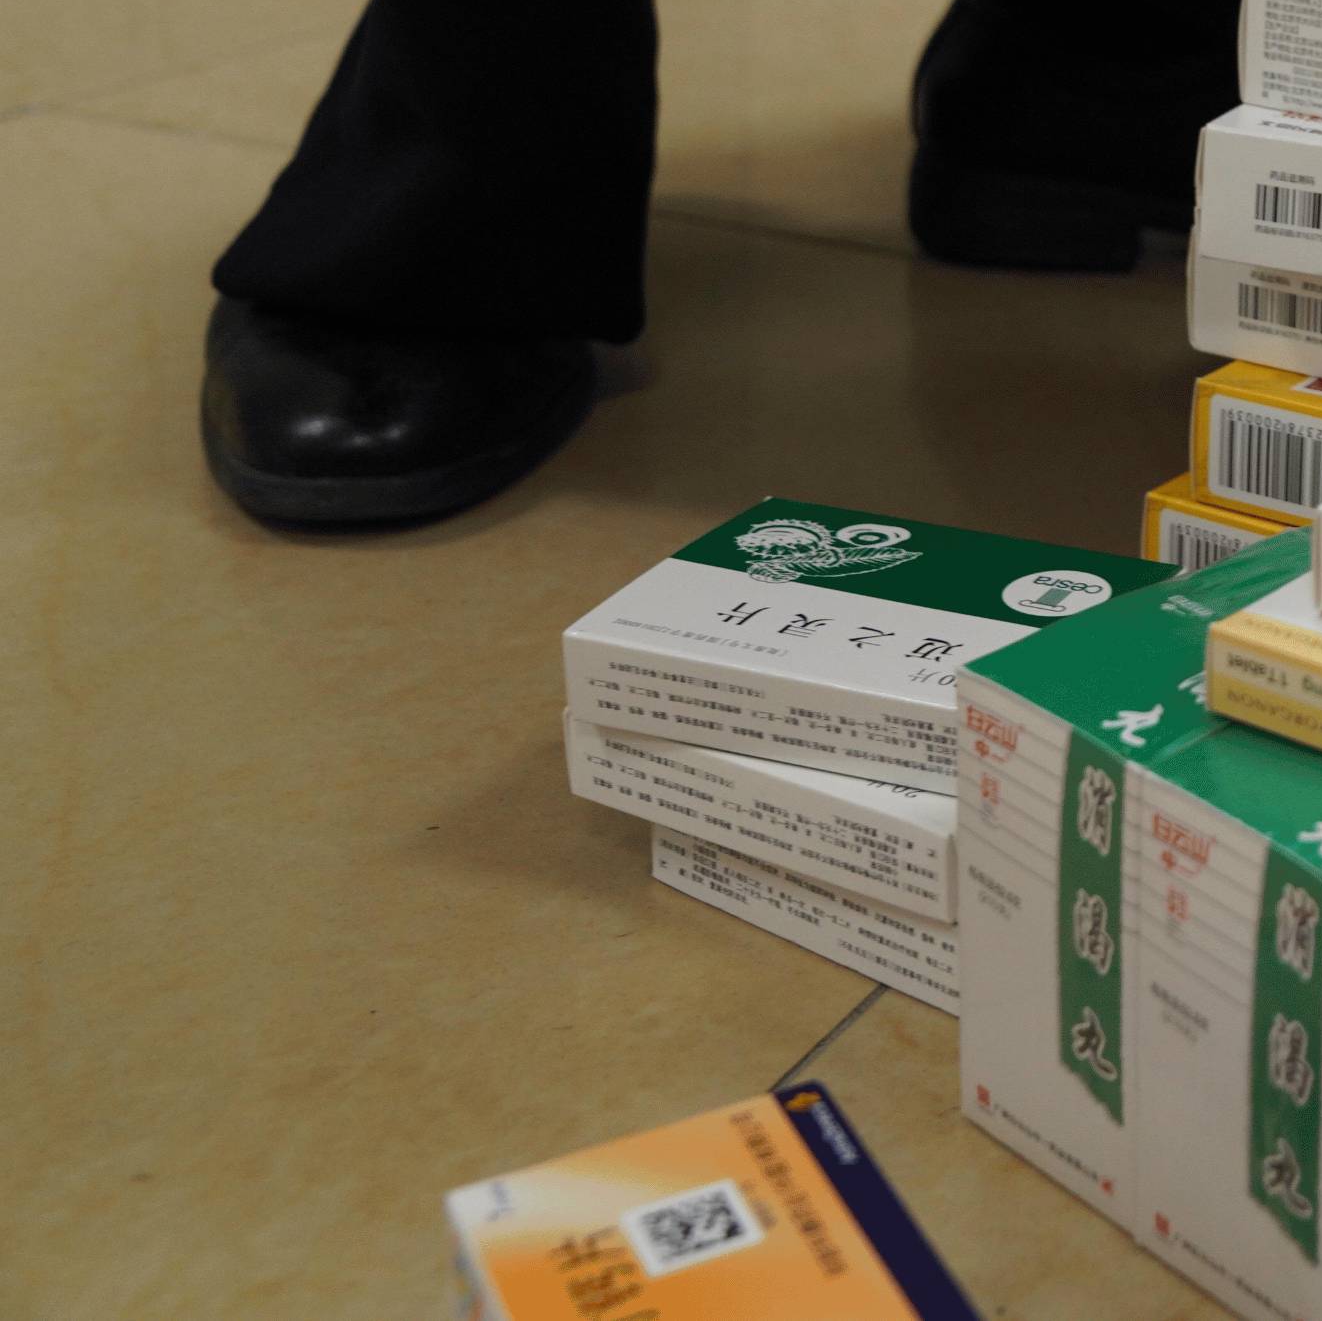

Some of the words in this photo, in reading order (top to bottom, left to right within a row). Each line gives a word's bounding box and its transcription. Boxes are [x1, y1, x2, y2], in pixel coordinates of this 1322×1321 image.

[1227, 407, 1281, 431] 200039
[1033, 573, 1105, 596] cesra
[714, 600, 965, 665] 迈之灵片
[908, 666, 959, 689] 0片
[1223, 652, 1292, 691] 1Tablet
[1071, 761, 1118, 1082] 消渴丸
[1261, 881, 1320, 1220] 消渴丸
